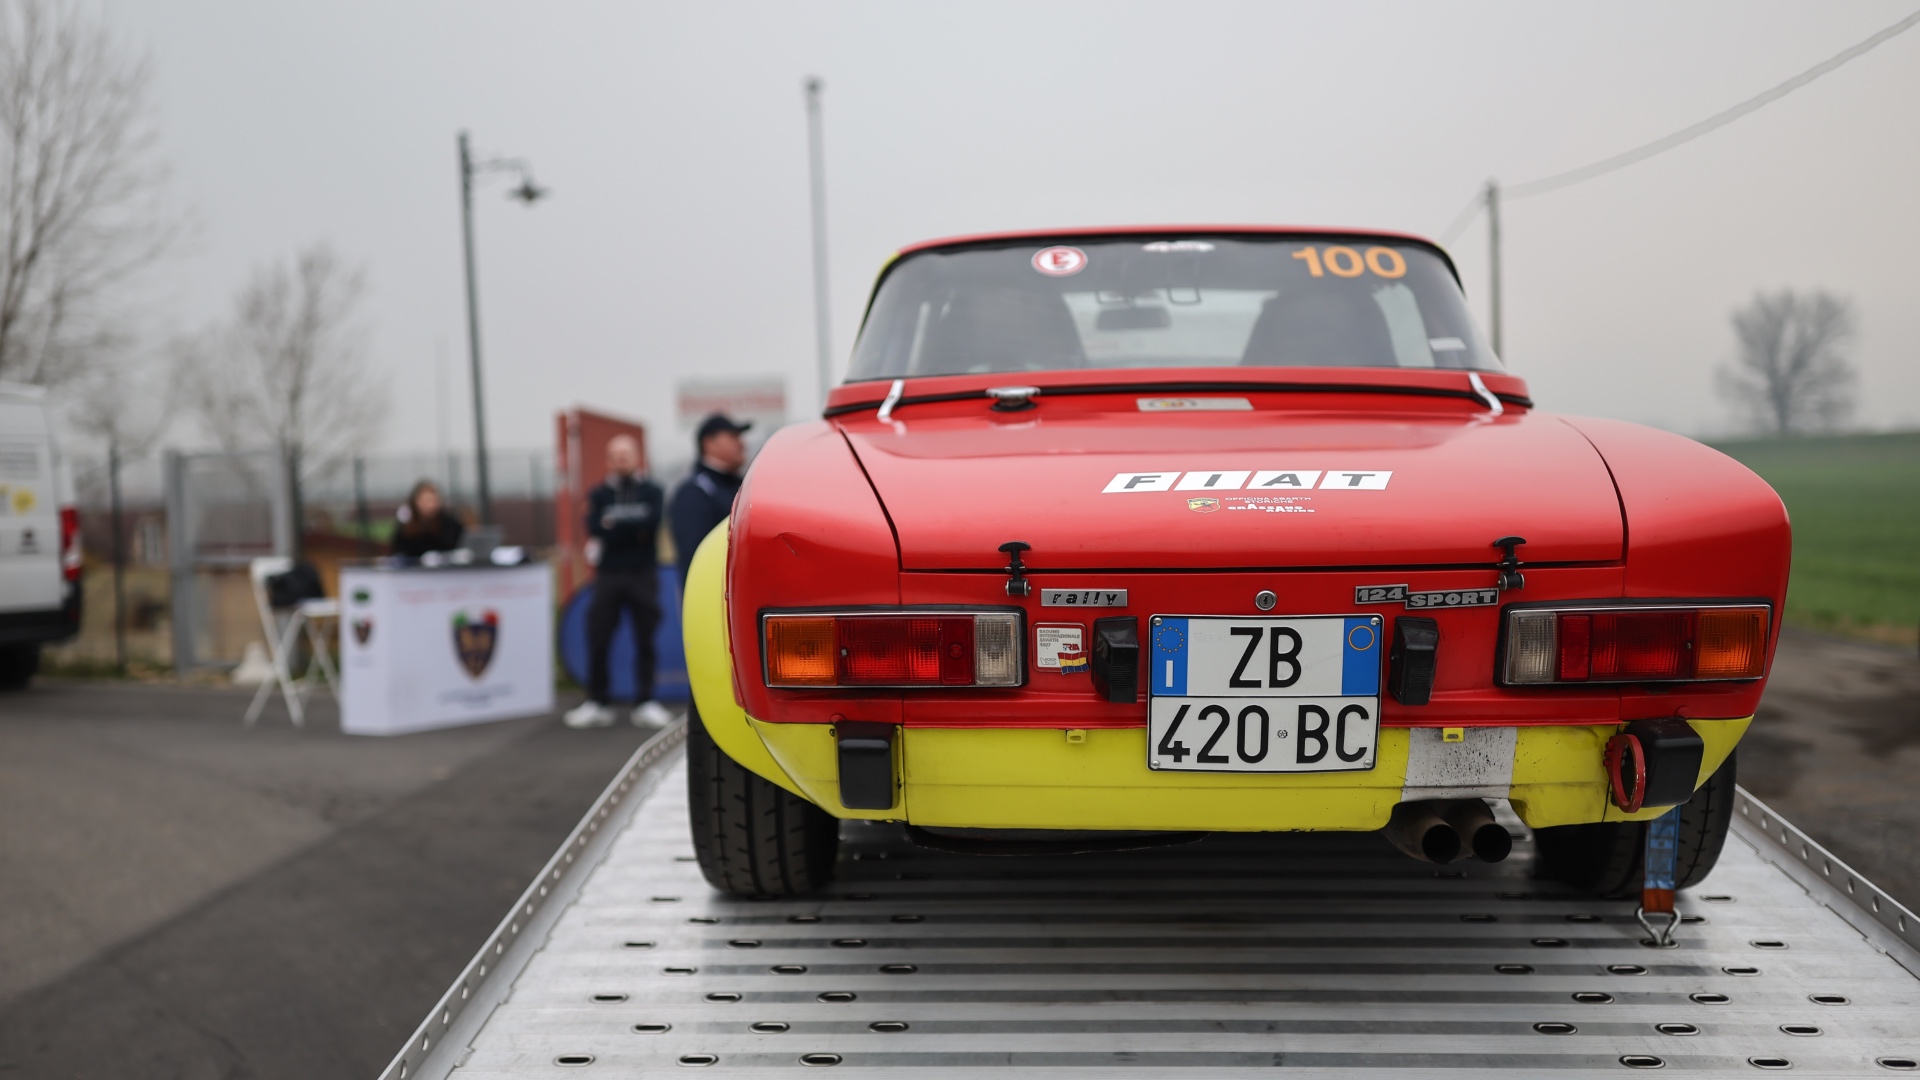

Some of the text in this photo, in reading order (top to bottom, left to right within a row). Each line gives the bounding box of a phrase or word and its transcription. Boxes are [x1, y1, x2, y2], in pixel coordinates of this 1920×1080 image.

[1052, 251, 1069, 266] E
[1291, 246, 1407, 279] 100
[1123, 473, 1376, 490] FIAT
[1052, 591, 1118, 606] rally
[1358, 587, 1496, 607] 124 SPORT
[1229, 627, 1303, 688] ZB
[1157, 704, 1370, 764] 420 BC
